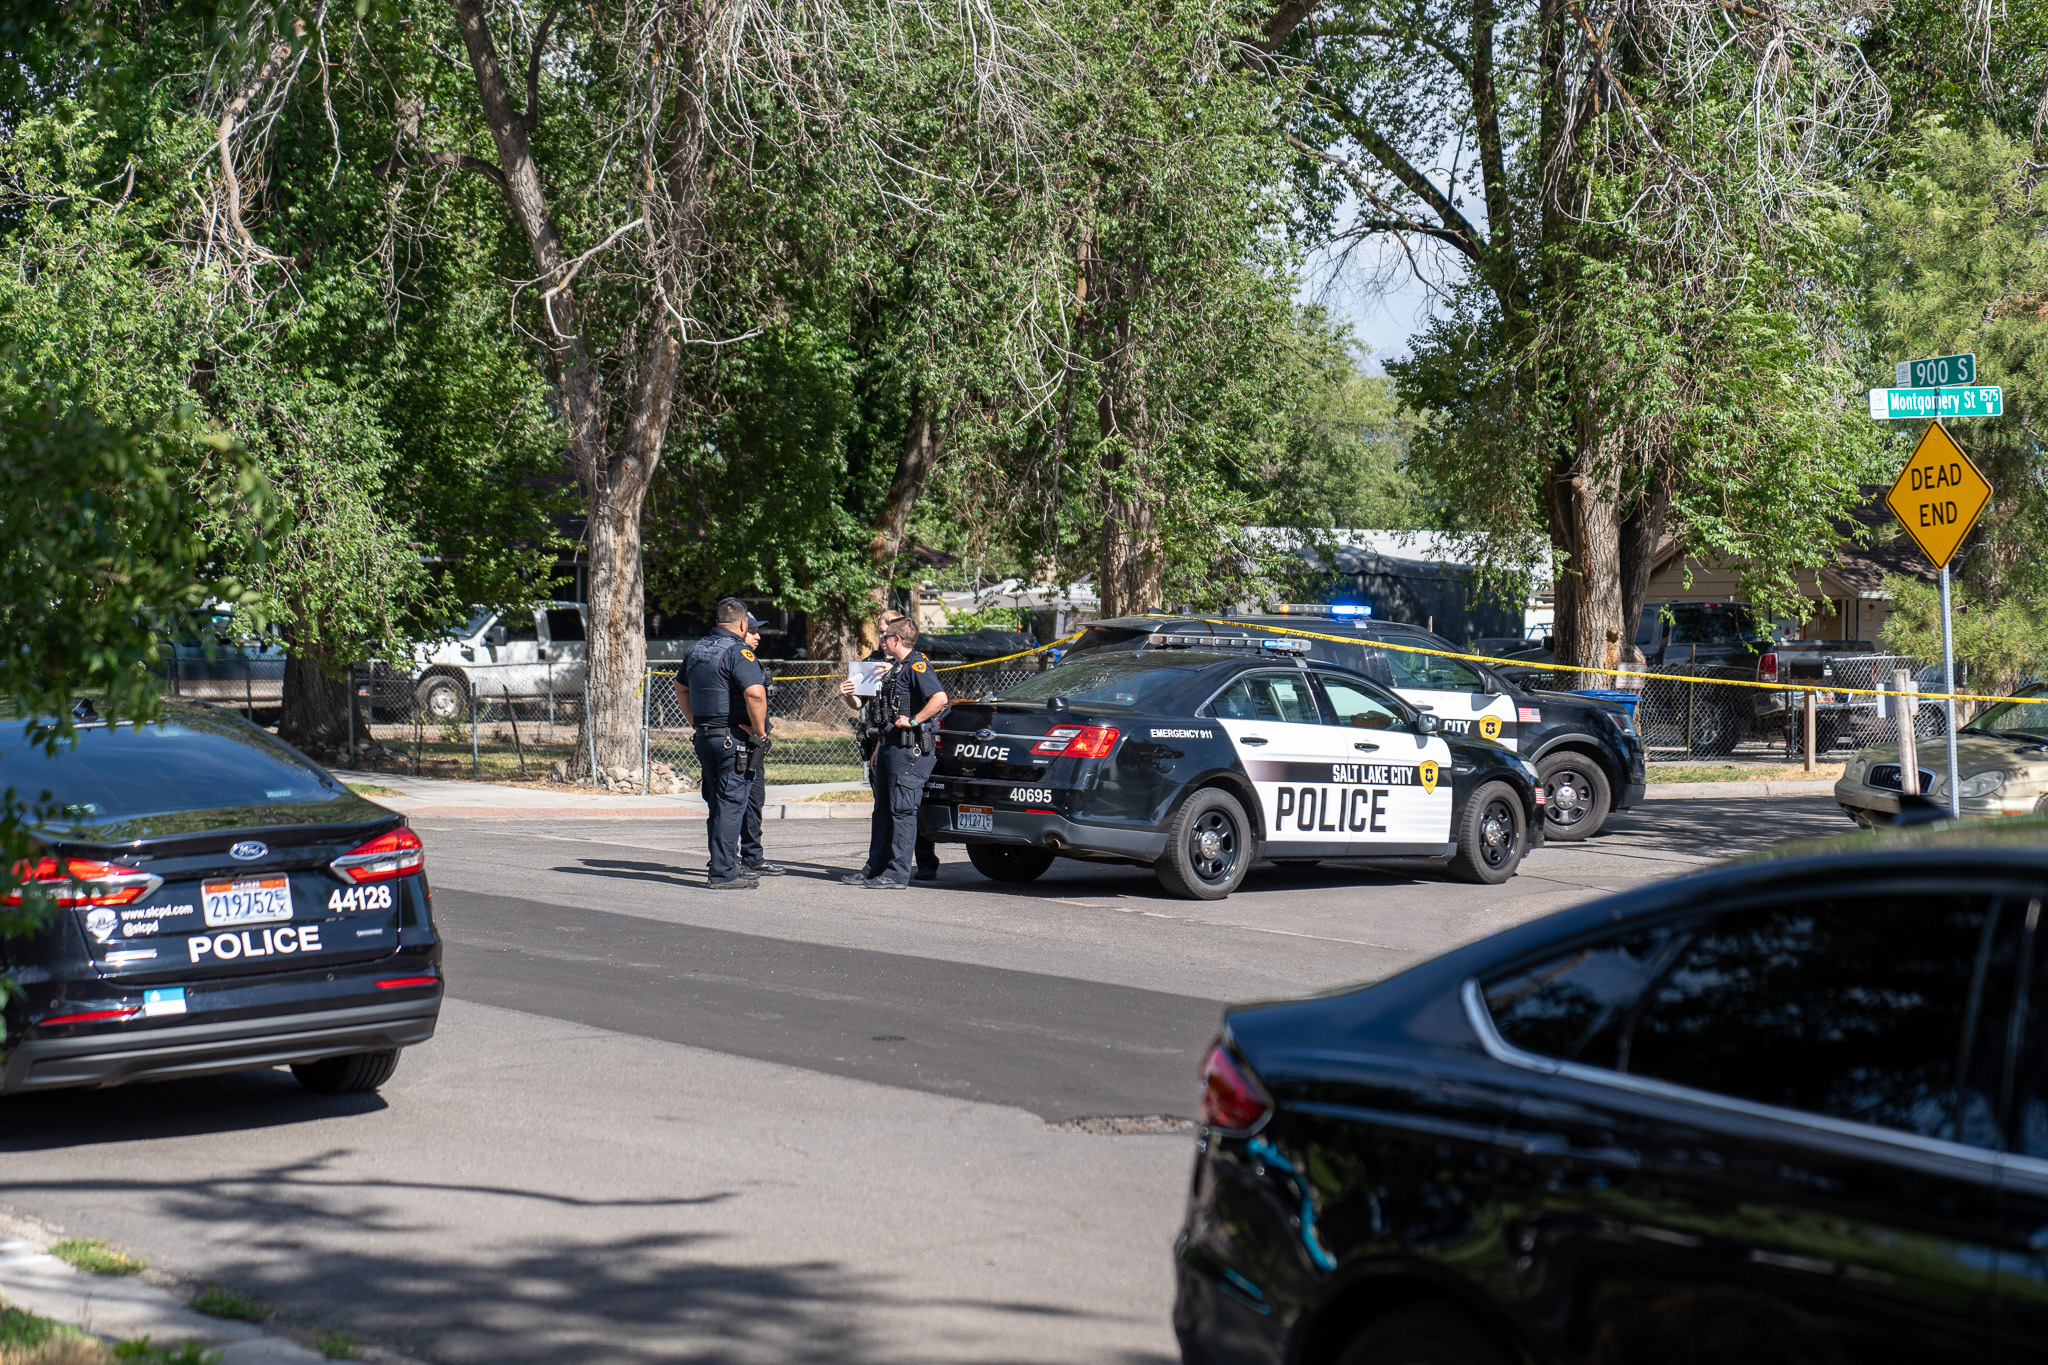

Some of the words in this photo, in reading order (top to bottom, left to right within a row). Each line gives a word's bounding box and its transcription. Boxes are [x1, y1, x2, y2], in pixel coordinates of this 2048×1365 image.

[1916, 359, 1949, 386] 900
[1957, 357, 1969, 381] S
[1890, 391, 1960, 416] Montgomery
[1963, 390, 1976, 409] St
[1979, 388, 1999, 402] 1575
[1985, 401, 1994, 414] W
[1911, 462, 1962, 492] DEAD
[1919, 500, 1958, 528] END
[1150, 728, 1199, 739] EMERGENCY
[1199, 729, 1214, 739] 911
[1443, 719, 1472, 735] CITY
[954, 743, 1011, 761] POLICE
[1332, 764, 1359, 783] SALT
[1360, 765, 1389, 784] LAKE
[1390, 766, 1414, 785] CITY
[1009, 787, 1053, 804] 40695
[1275, 786, 1389, 834] POLICE
[210, 891, 276, 919] 219752
[327, 883, 392, 914] 44128
[120, 903, 194, 921] www.slcpd.com
[122, 918, 160, 938] @slcpd
[187, 924, 323, 964] POLICE
